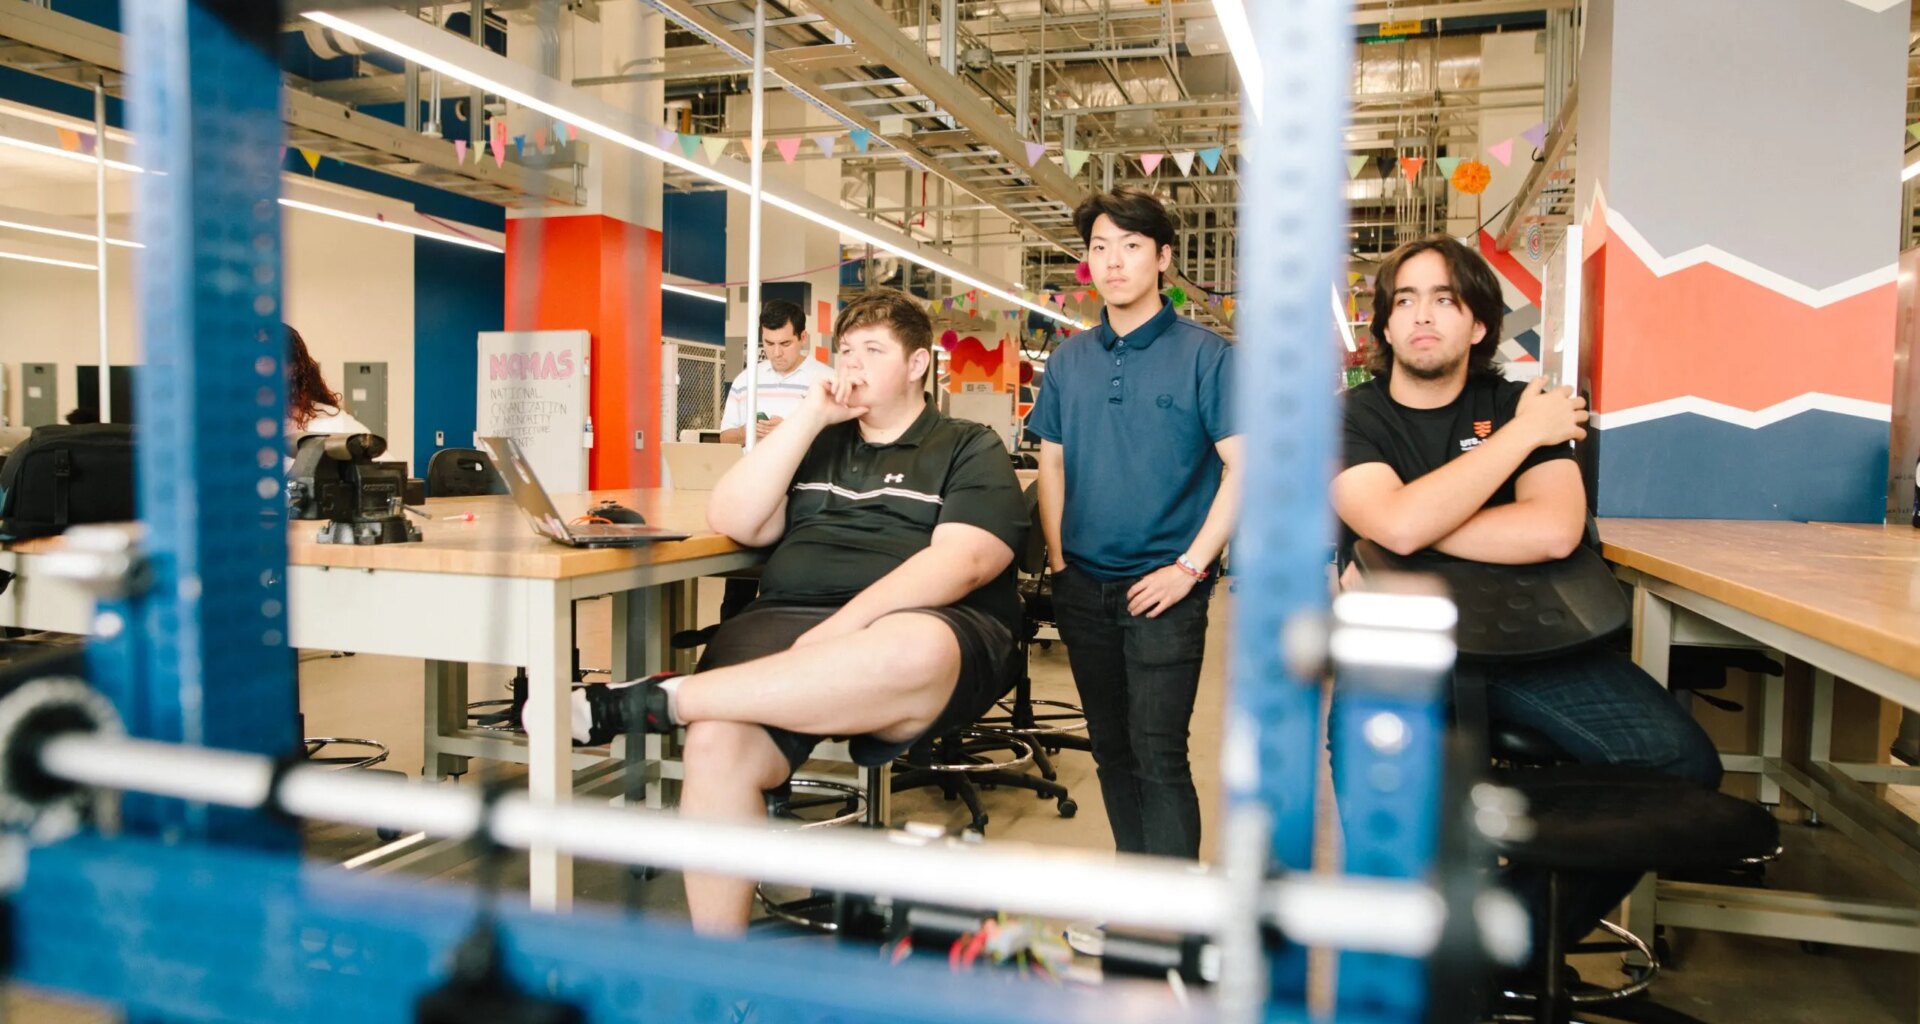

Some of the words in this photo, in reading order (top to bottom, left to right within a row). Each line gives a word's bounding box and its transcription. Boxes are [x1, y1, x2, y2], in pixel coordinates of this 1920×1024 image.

[489, 349, 574, 380] NOMAS
[490, 387, 543, 400] NATIONAL
[490, 401, 567, 415] ORGANIZATION
